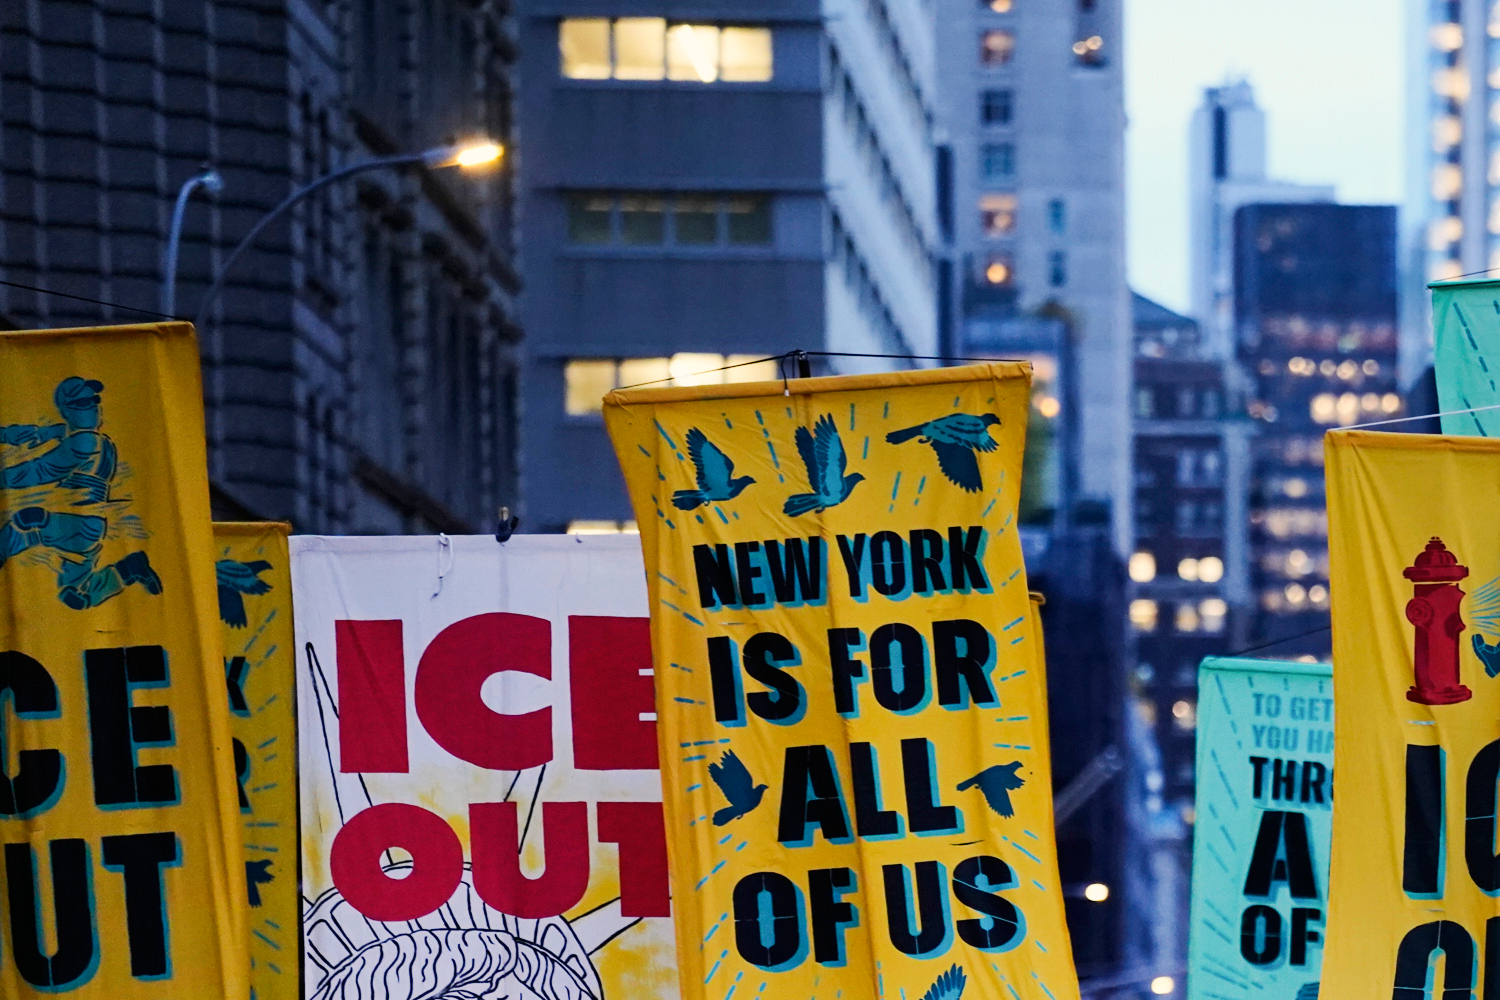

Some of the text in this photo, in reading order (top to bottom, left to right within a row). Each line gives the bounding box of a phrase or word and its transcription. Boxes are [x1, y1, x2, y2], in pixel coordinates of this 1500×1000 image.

[693, 525, 992, 611] NEW YORK
[334, 611, 660, 774] ICE
[706, 619, 1001, 728] IS FOR
[1252, 693, 1333, 722] TO GET
[0, 645, 182, 820] CE
[1252, 724, 1299, 751] YOU
[777, 737, 965, 848] ALL
[4, 831, 184, 992] UT
[330, 802, 671, 922] OUT
[732, 854, 1028, 972] OF US
[1240, 904, 1326, 968] OF
